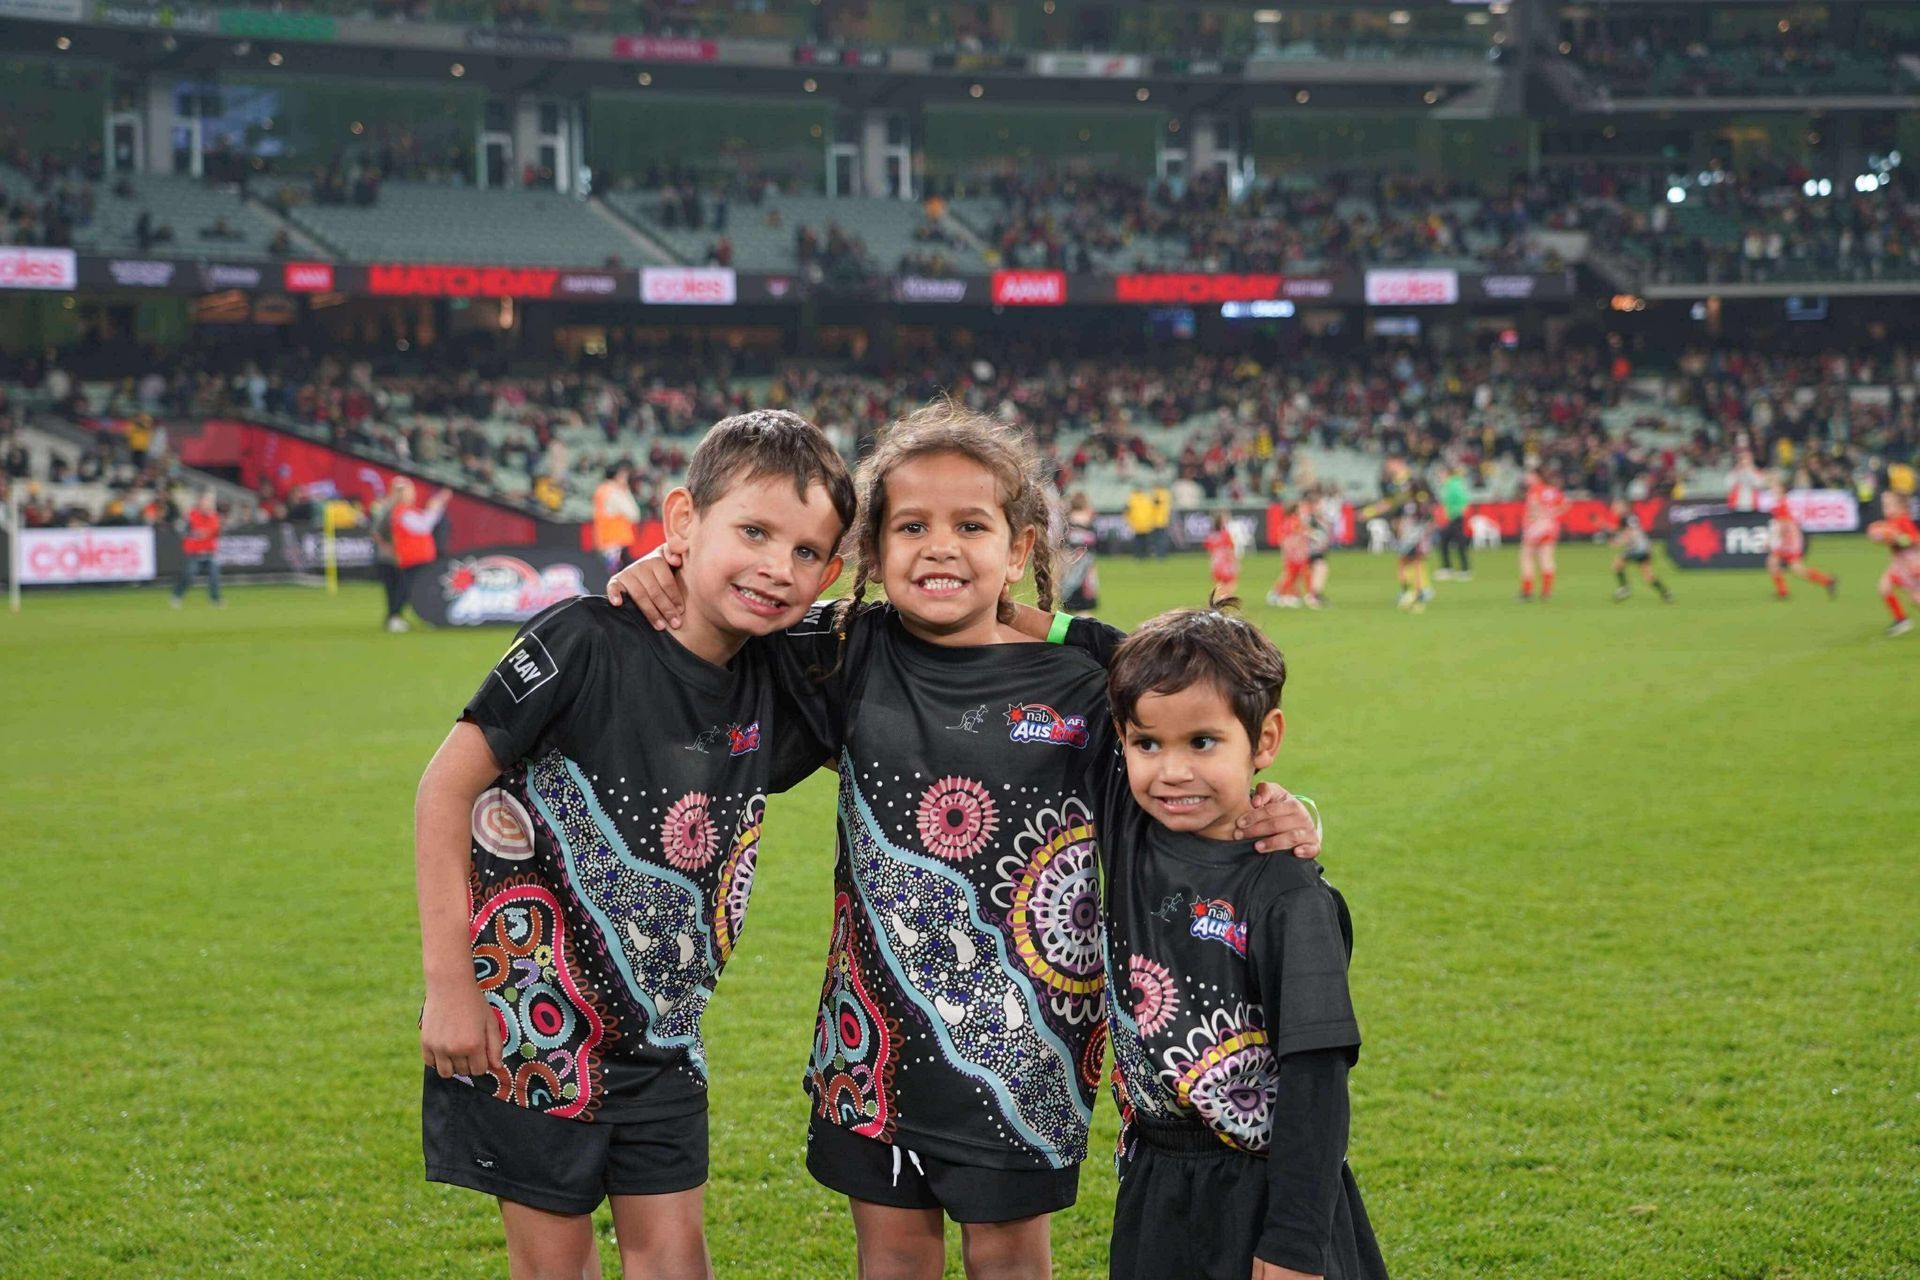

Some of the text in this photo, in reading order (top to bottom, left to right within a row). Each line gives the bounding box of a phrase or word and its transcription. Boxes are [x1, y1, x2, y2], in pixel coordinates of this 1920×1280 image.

[0, 246, 65, 285] oles
[368, 264, 559, 298] MATCHDAY
[652, 268, 724, 302] coles
[1115, 275, 1283, 303] MATCHDAY
[1376, 273, 1446, 304] coles
[28, 528, 142, 578] coles
[508, 648, 542, 684] PLAY
[1026, 710, 1049, 723] nab
[1067, 718, 1085, 727] AFL
[1208, 908, 1229, 921] nab
